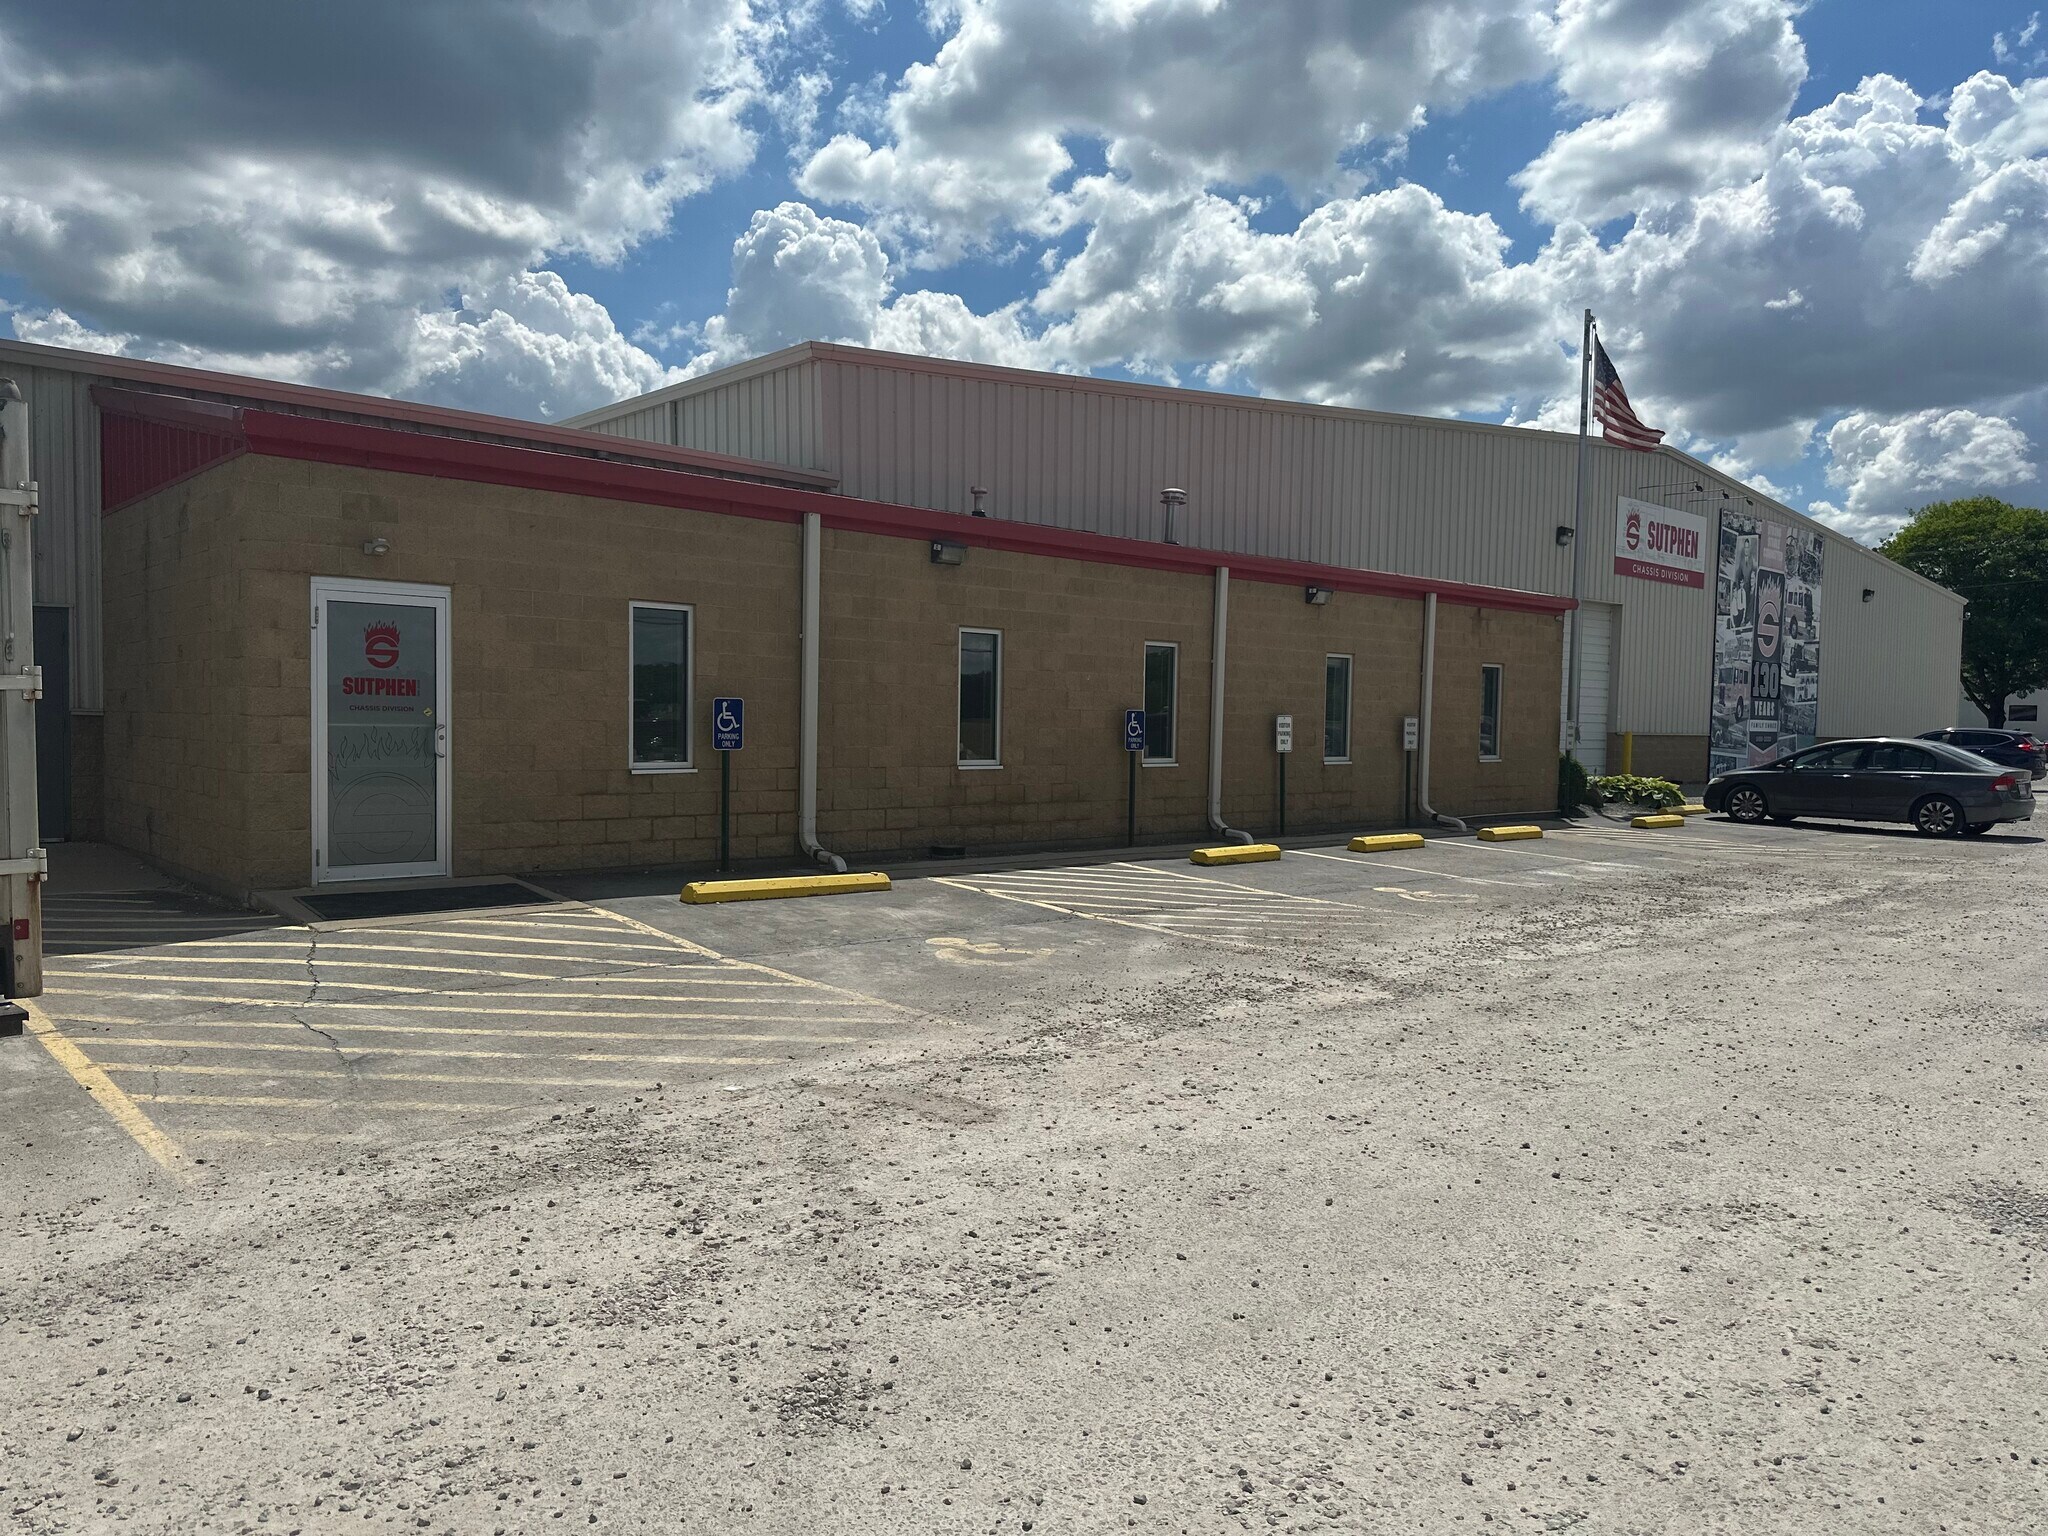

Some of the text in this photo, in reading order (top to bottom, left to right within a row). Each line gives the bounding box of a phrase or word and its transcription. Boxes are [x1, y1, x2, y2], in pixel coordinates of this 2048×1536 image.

[1647, 520, 1699, 559] SUTPHEN
[1632, 563, 1689, 582] CHASSIS DIVISION
[342, 676, 417, 697] SUTPHEN
[1752, 661, 1779, 698] 130
[349, 704, 380, 712] CHASSIS
[1754, 700, 1775, 717] YEARS
